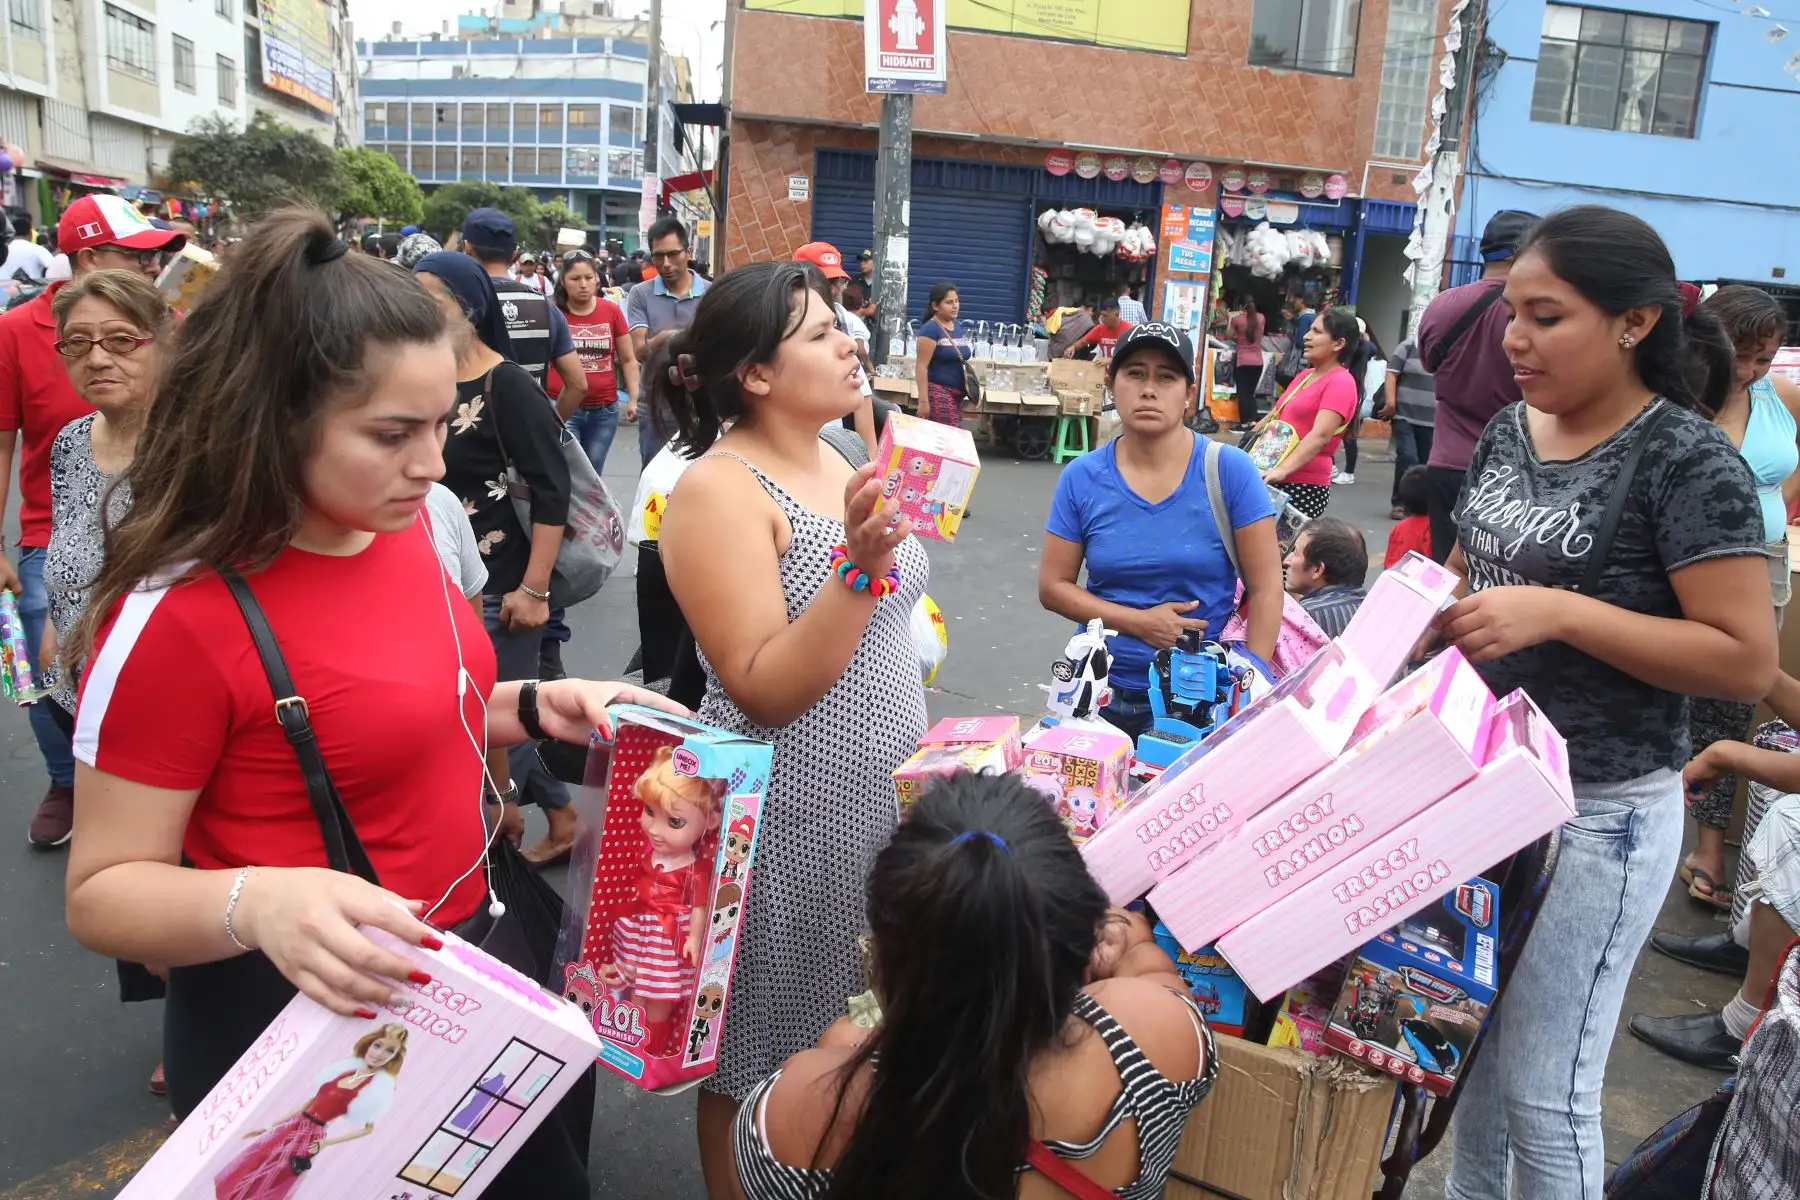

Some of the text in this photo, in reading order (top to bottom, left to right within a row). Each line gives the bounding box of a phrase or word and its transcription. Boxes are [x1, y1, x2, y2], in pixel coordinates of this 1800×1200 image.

[882, 55, 932, 69] HIDRANTE
[1461, 466, 1593, 561] Stronger
[1471, 526, 1500, 557] THAN
[676, 753, 697, 768] UNBOX
[680, 762, 691, 772] ME!
[1147, 803, 1233, 872] FASHION
[1264, 813, 1365, 888] FASHION
[1344, 859, 1451, 935] FASHION
[598, 1025, 635, 1043] SURPRISE!
[600, 1000, 644, 1037] LOL
